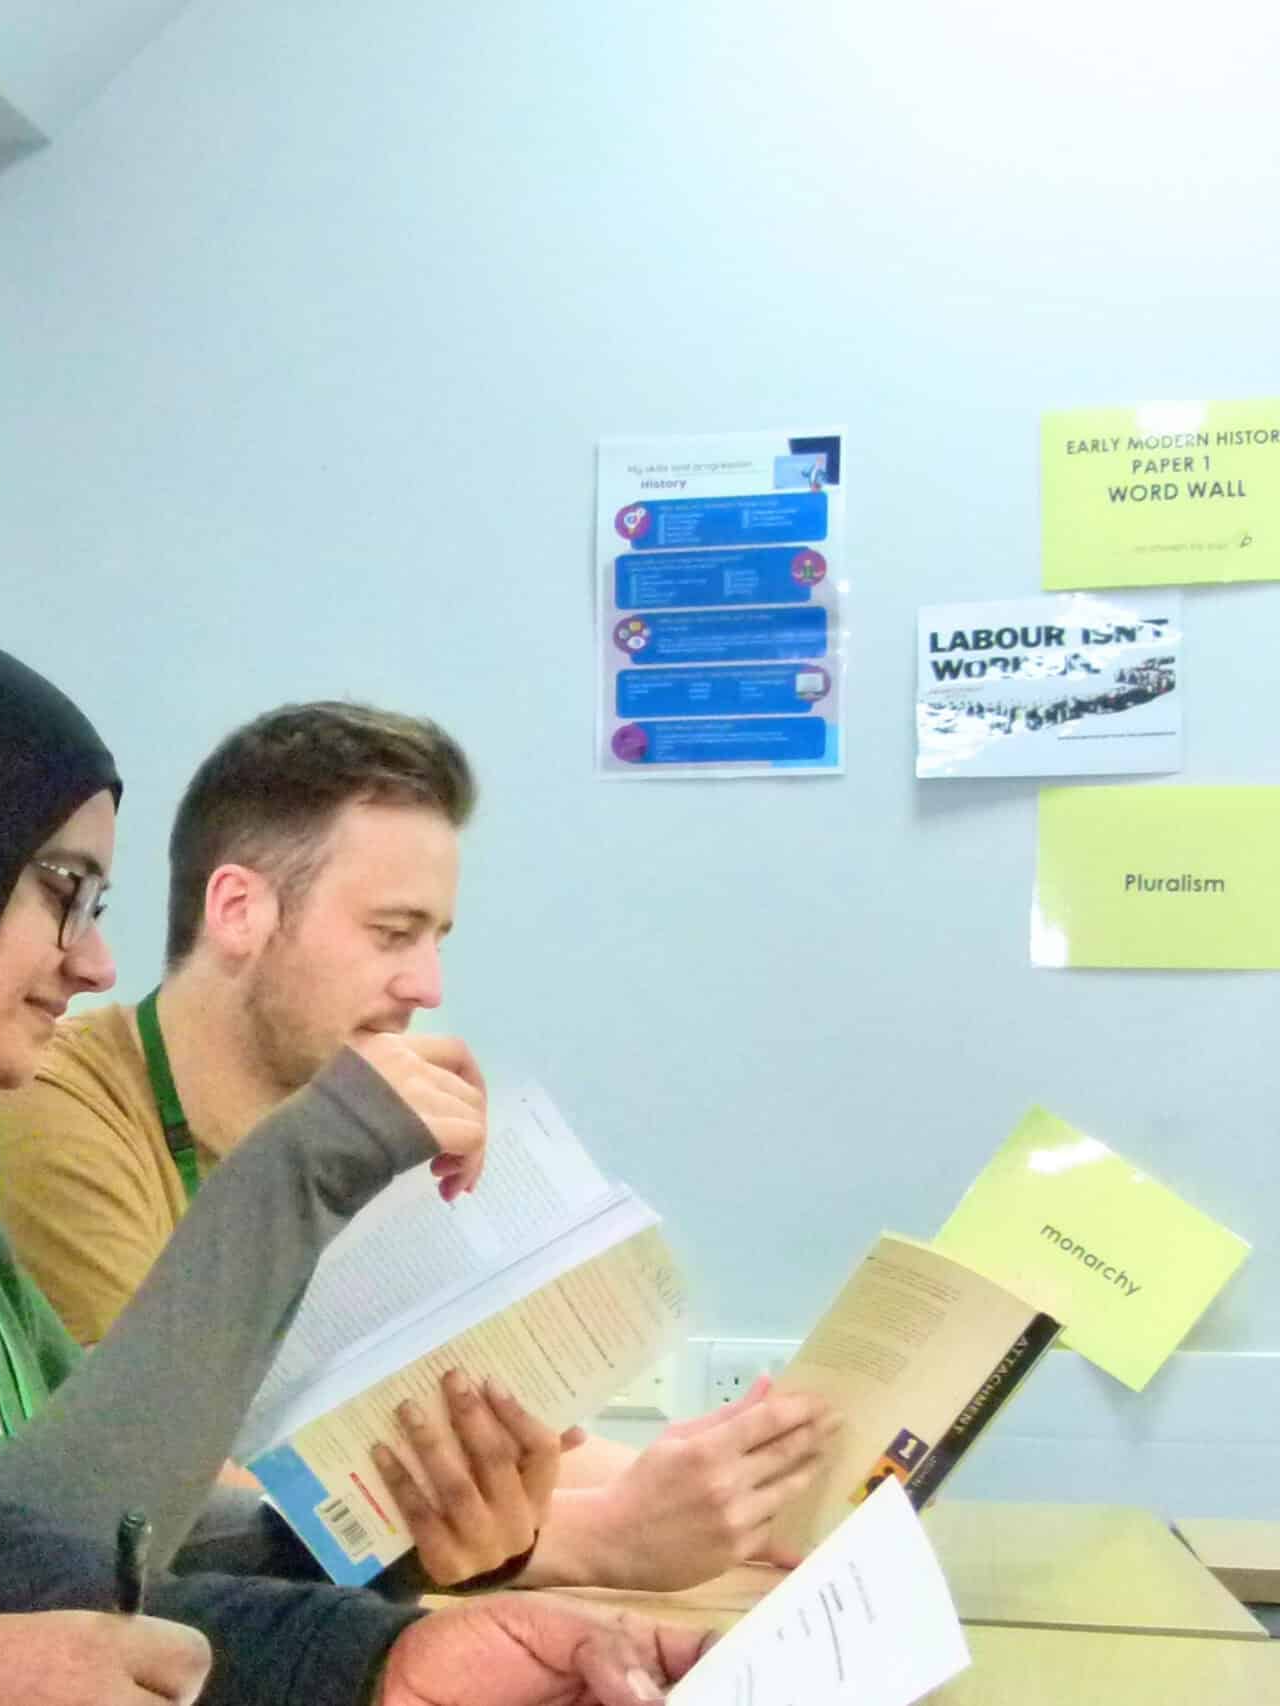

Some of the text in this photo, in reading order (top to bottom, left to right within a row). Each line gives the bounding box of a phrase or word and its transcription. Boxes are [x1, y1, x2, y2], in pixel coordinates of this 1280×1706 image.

[1066, 438, 1120, 455] EARLY
[1127, 433, 1209, 451] MODERN
[1131, 455, 1211, 474] PAPER 1
[640, 479, 687, 491] History
[1108, 479, 1247, 503] WORD WALL
[929, 625, 1065, 653] LABOUR
[1124, 873, 1225, 892] Pluralism
[1040, 1224, 1142, 1297] monarchy
